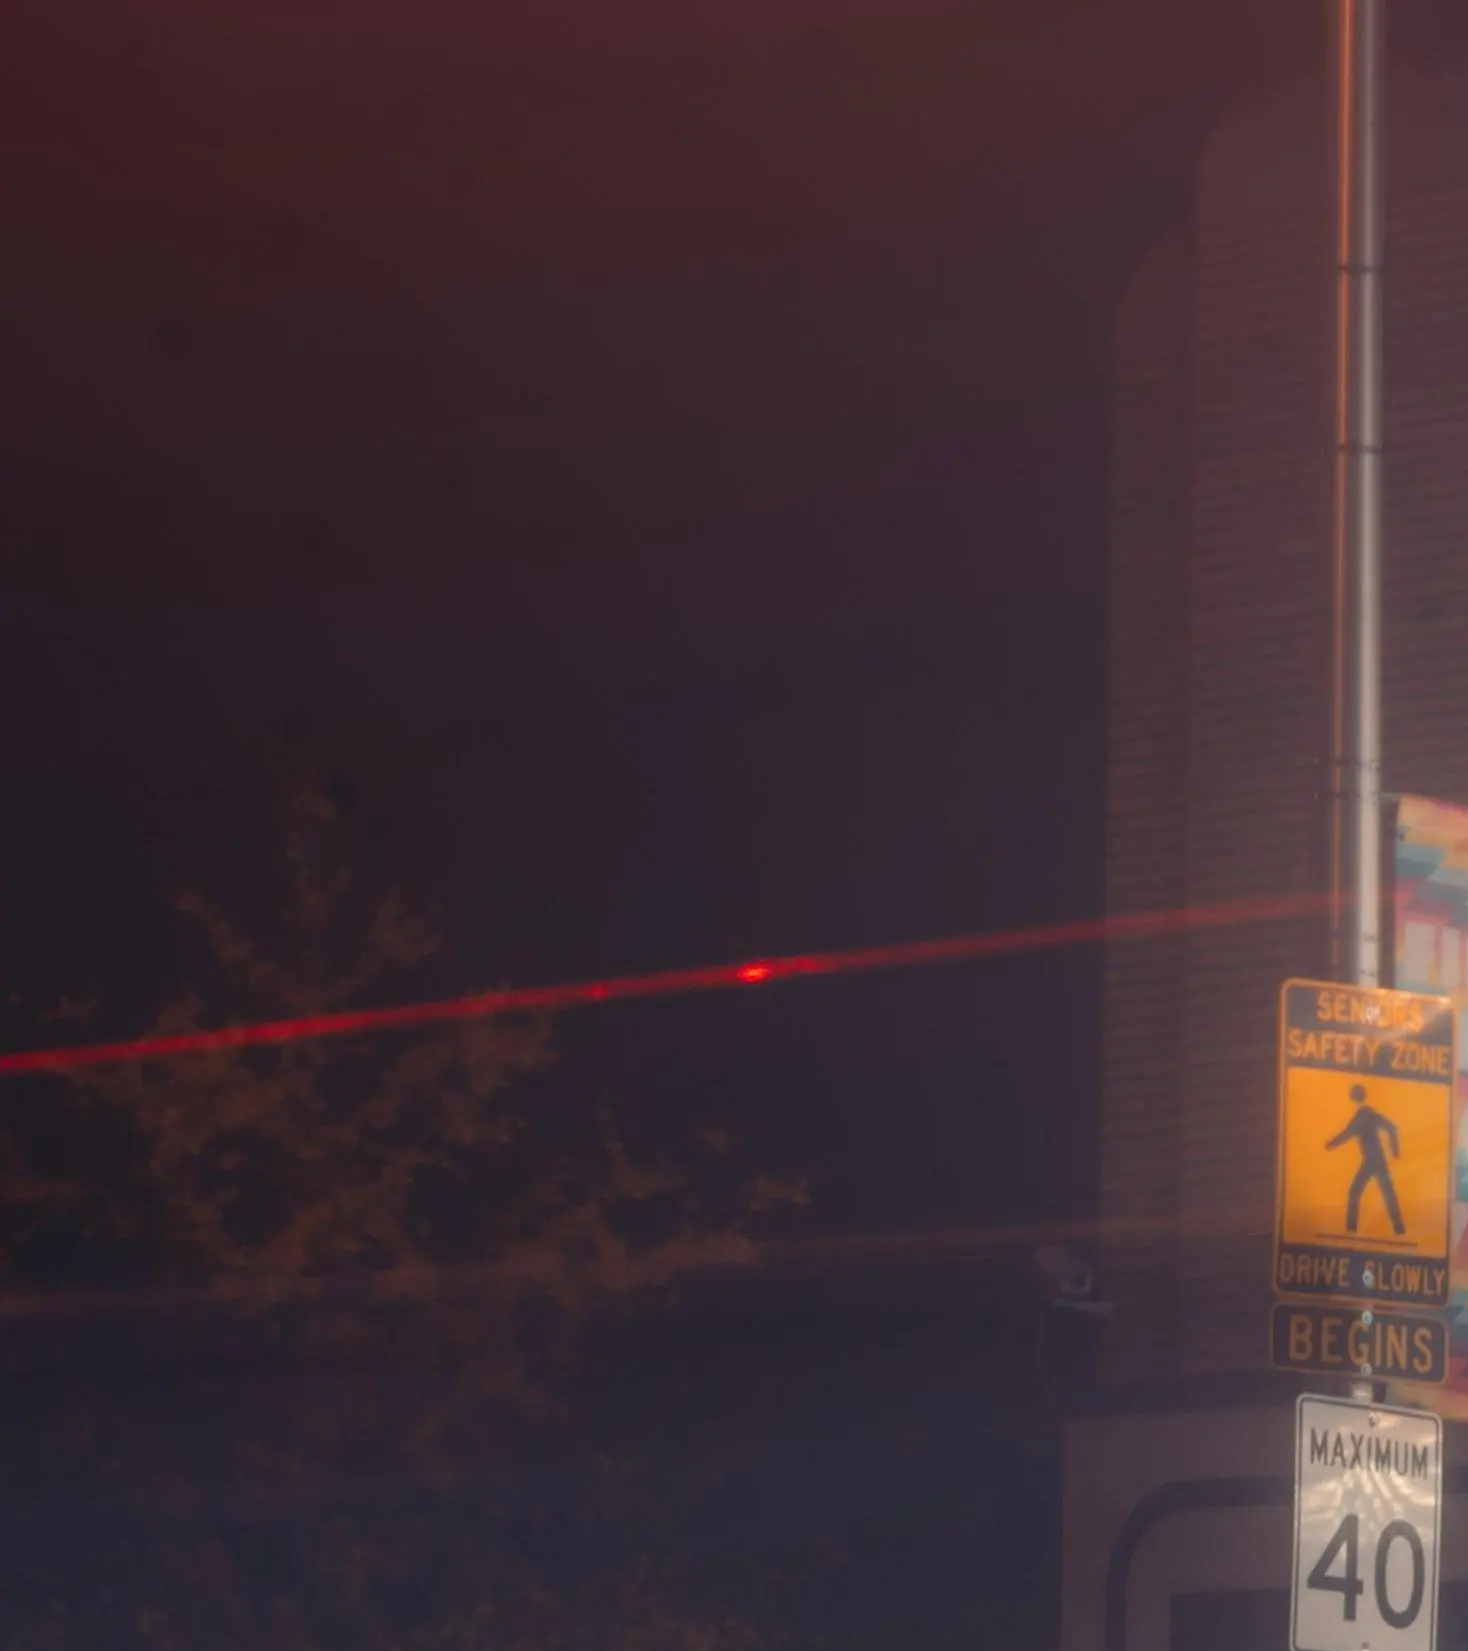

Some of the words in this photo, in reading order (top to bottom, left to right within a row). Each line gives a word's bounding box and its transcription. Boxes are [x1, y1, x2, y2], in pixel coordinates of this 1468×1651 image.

[1317, 991, 1423, 1032] SENIORS
[1287, 1028, 1380, 1070] SAFETY
[1390, 1037, 1450, 1076] ZONE
[1279, 1252, 1350, 1288] DRIVE
[1363, 1260, 1447, 1299] SLOWLY
[1289, 1313, 1434, 1375] BEGINS
[1310, 1427, 1430, 1481] MAXIMUM
[1306, 1511, 1427, 1631] 40
